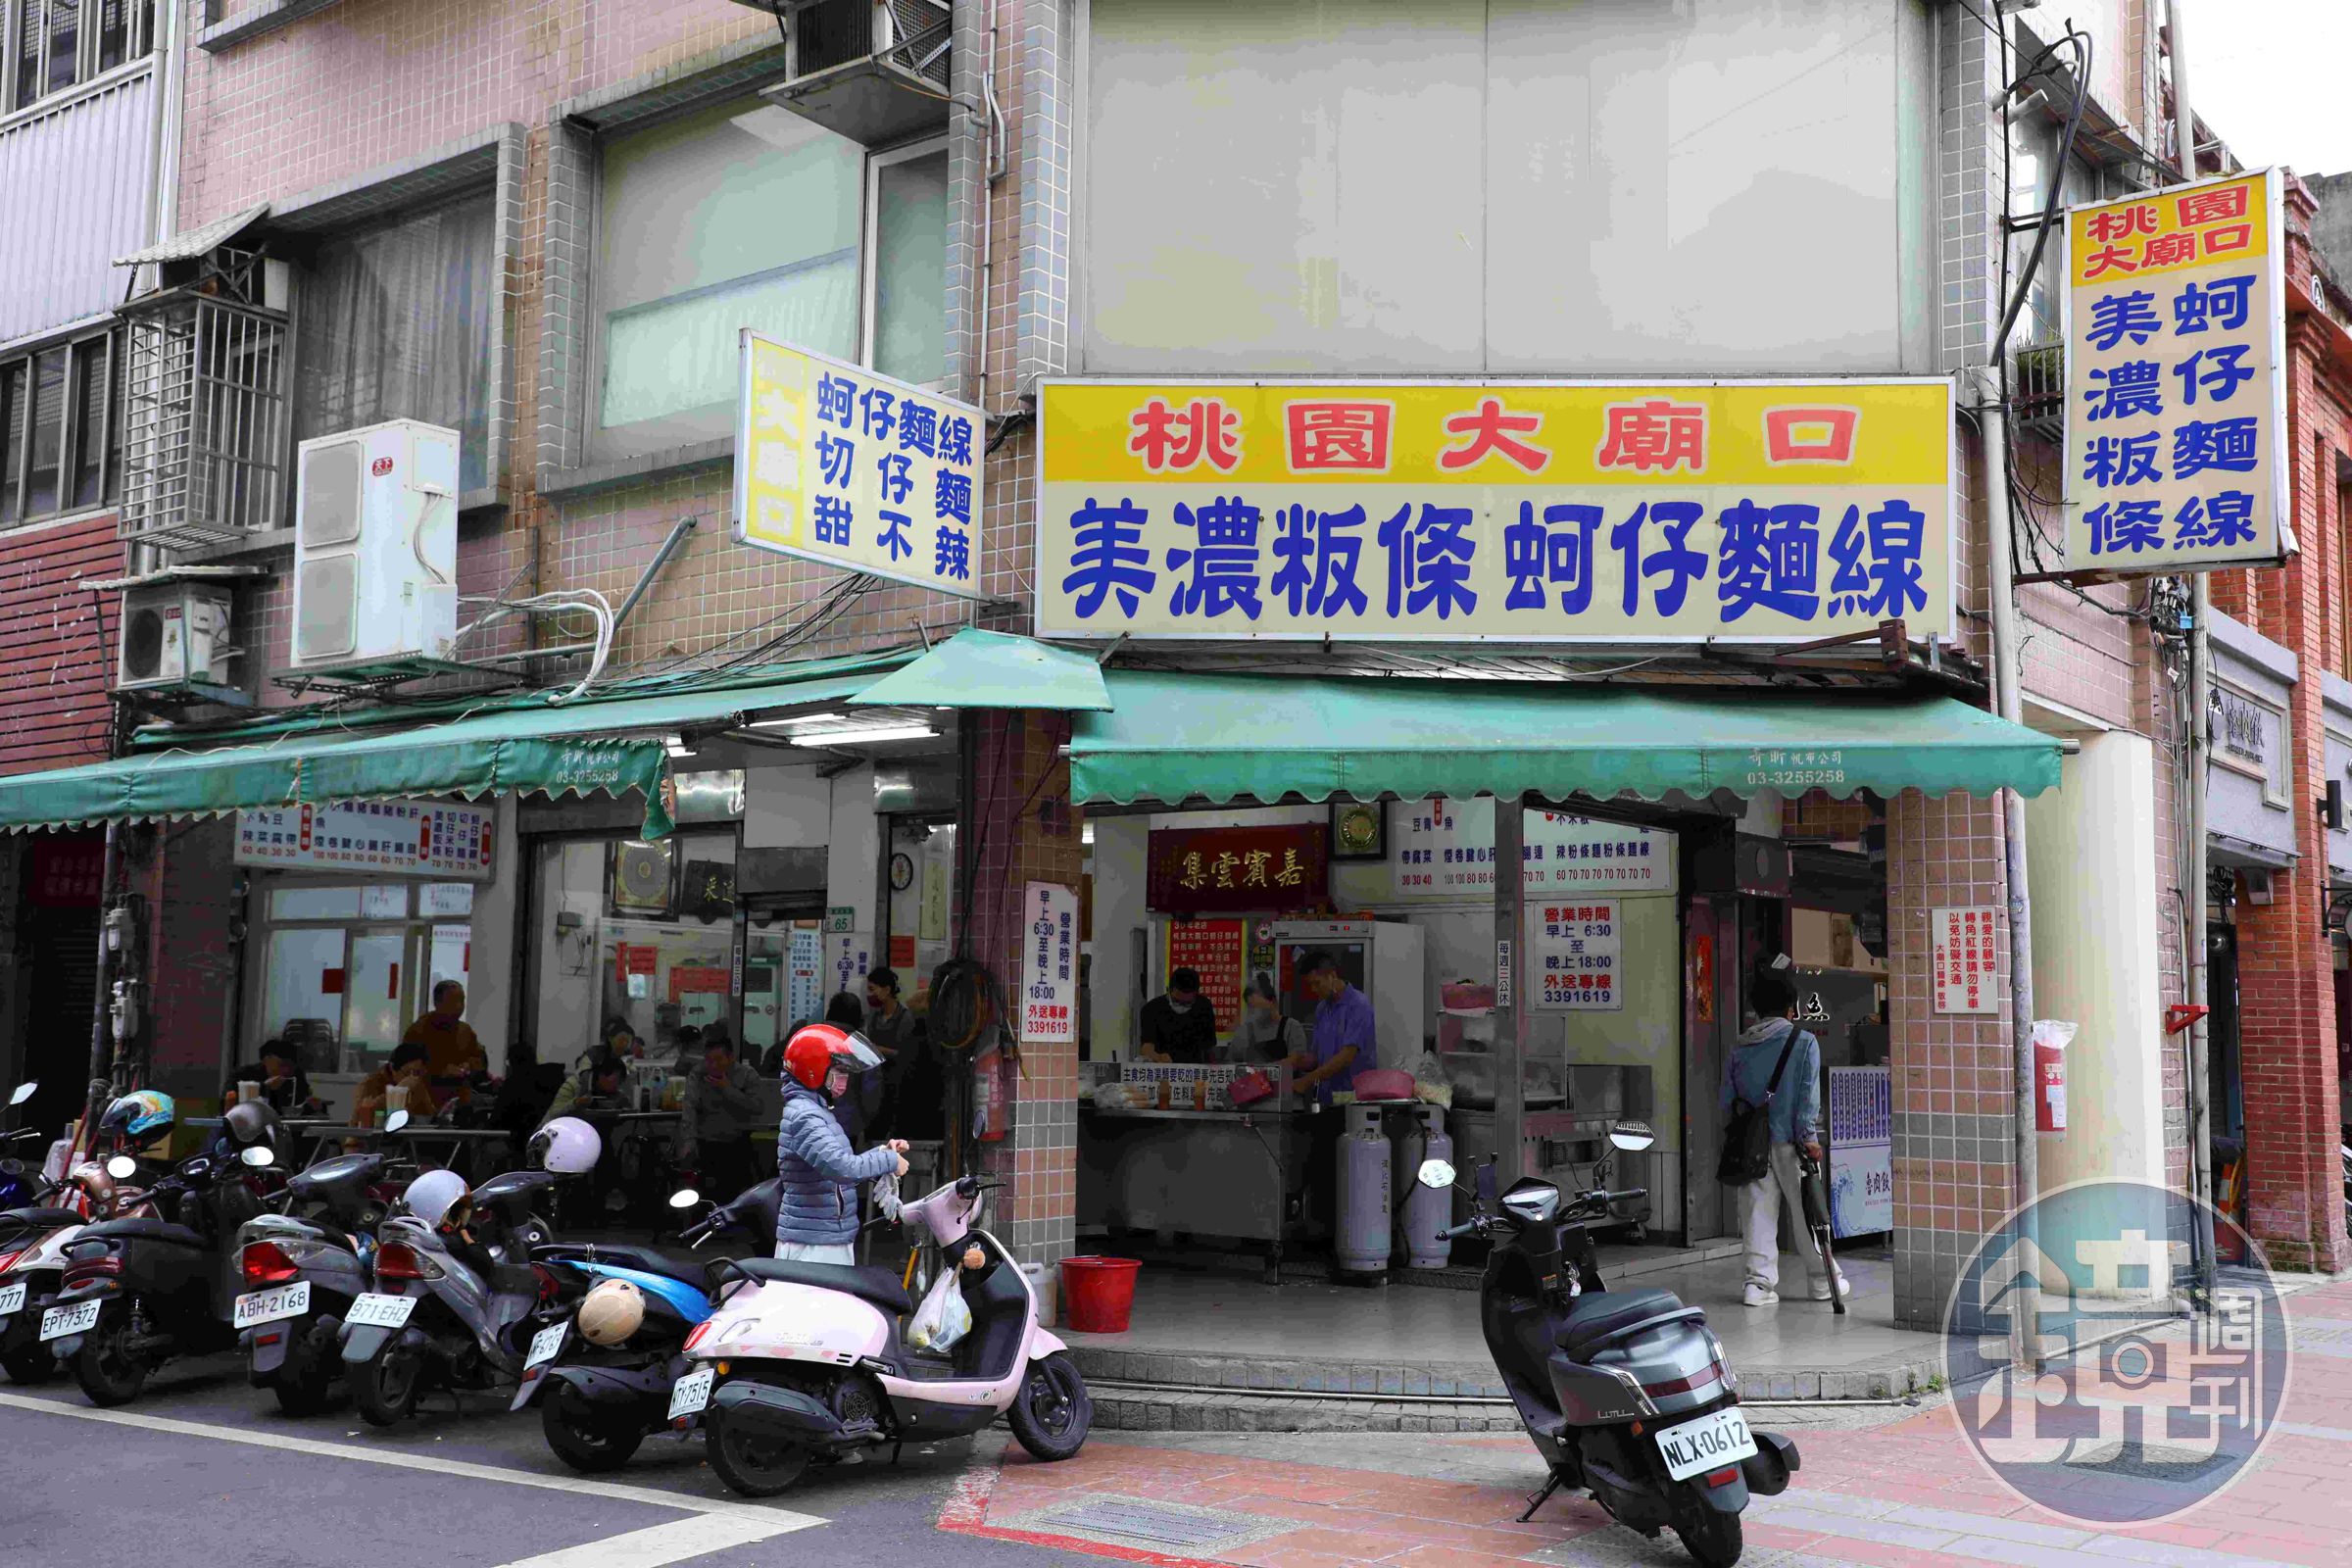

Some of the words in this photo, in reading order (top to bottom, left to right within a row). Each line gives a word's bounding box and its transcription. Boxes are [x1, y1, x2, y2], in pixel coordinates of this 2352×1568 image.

[2086, 184, 2249, 241] 桃園
[2083, 223, 2253, 278] 大廟口
[817, 370, 973, 466] 蚵仔麵線
[2082, 290, 2166, 555] 美濃粄條
[2173, 274, 2258, 550] 蚵仔麵線
[1130, 399, 1858, 470] 桃園大廟口
[814, 430, 972, 525] 切仔麵
[813, 493, 970, 581] 甜不辣
[556, 770, 619, 784] 03-3255258
[1747, 769, 1844, 784] 03-3255258
[835, 917, 848, 930] 65
[1544, 906, 1610, 922] 營業時間
[1584, 924, 1611, 937] 6:30
[1058, 911, 1071, 981] 營業時間
[1570, 940, 1585, 954] 至
[1948, 912, 1962, 985] 以免妨礙交通
[1964, 911, 1979, 1009] 轉角紅線請勿停車
[1498, 943, 1509, 1004] 每週三公休
[1544, 973, 1612, 989] 外送專線
[1028, 1004, 1068, 1019] 外送專線
[1544, 990, 1610, 1003] 3391619
[1027, 1020, 1068, 1034] 3391619
[43, 1307, 97, 1334] EPT-7372
[237, 1291, 307, 1320] ABH-2168
[350, 1302, 410, 1323] 971-EHZ
[1663, 1420, 1751, 1469] NLX-0612
